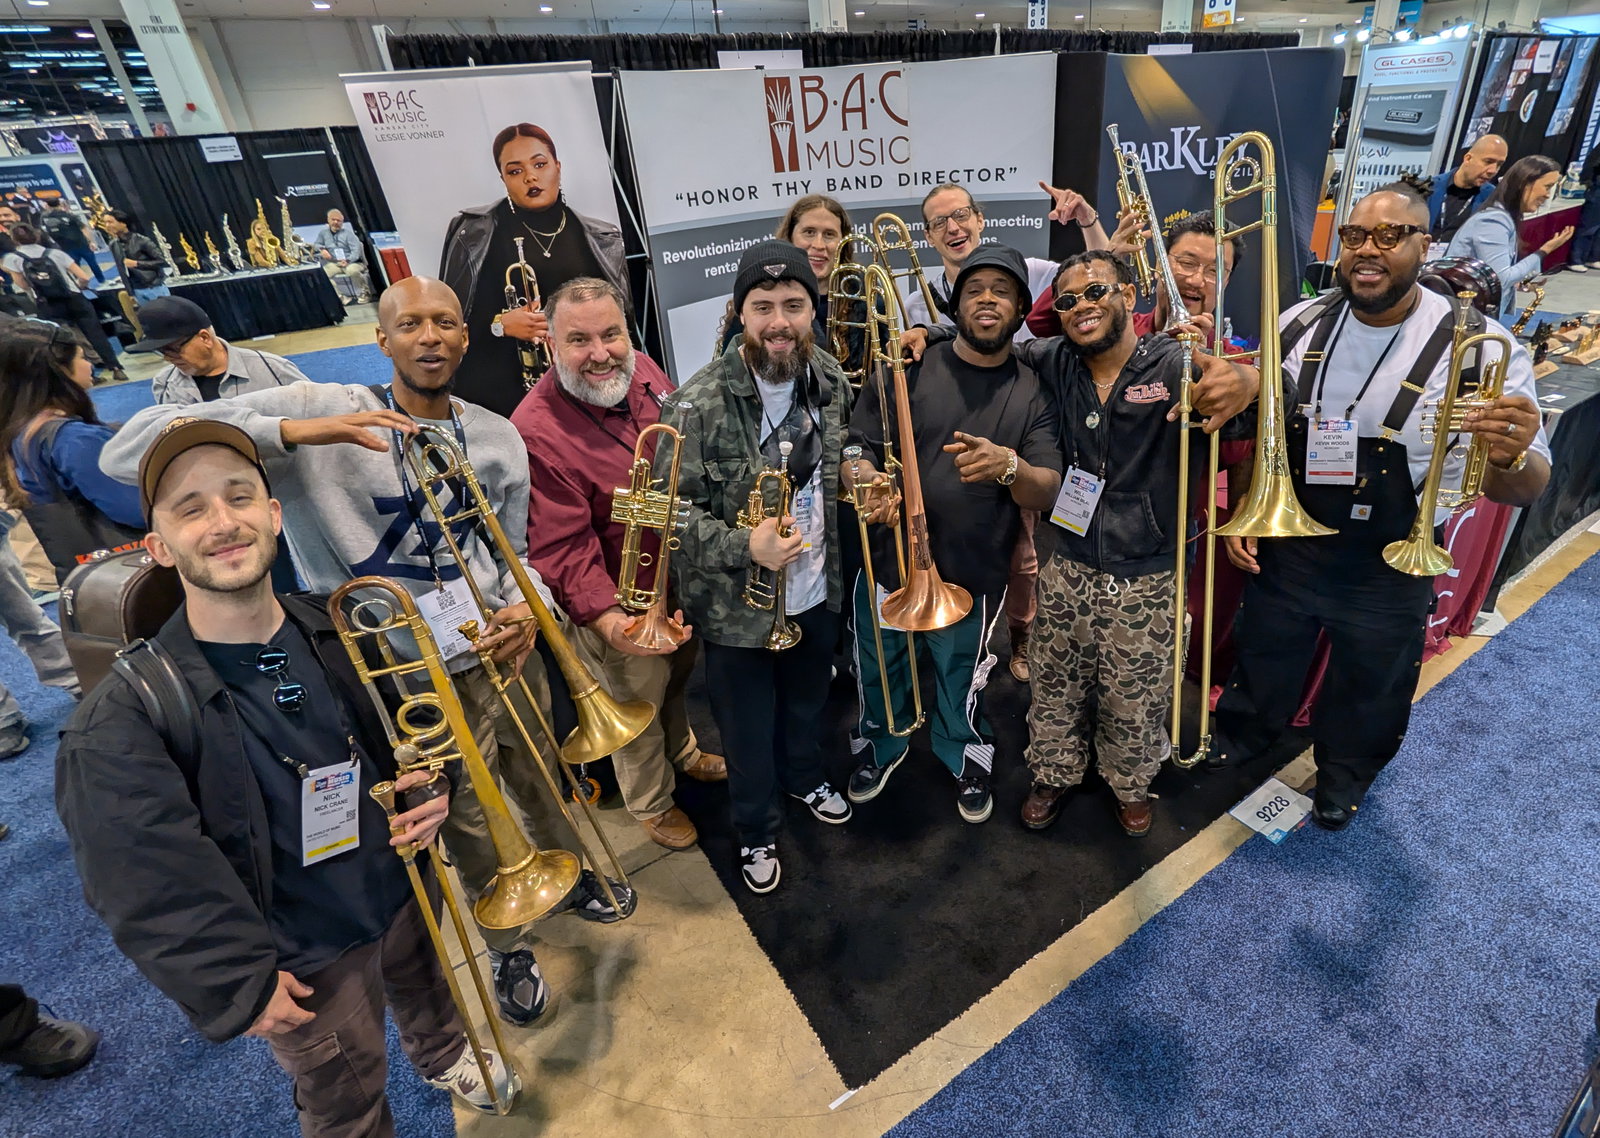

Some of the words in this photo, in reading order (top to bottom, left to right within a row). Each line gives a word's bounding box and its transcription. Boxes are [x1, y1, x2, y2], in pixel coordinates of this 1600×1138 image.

[1400, 56, 1445, 66] CASES
[385, 110, 428, 124] MUSIC
[375, 132, 407, 143] LESSIE
[406, 129, 446, 140] VONNER
[806, 135, 911, 171] MUSIC
[1209, 168, 1253, 181] BZIL
[772, 179, 812, 198] THY
[826, 174, 883, 192] BAND
[323, 792, 341, 802] NICK
[314, 803, 330, 813] NICK
[329, 798, 349, 809] CRANE
[1255, 795, 1291, 823] 9228
